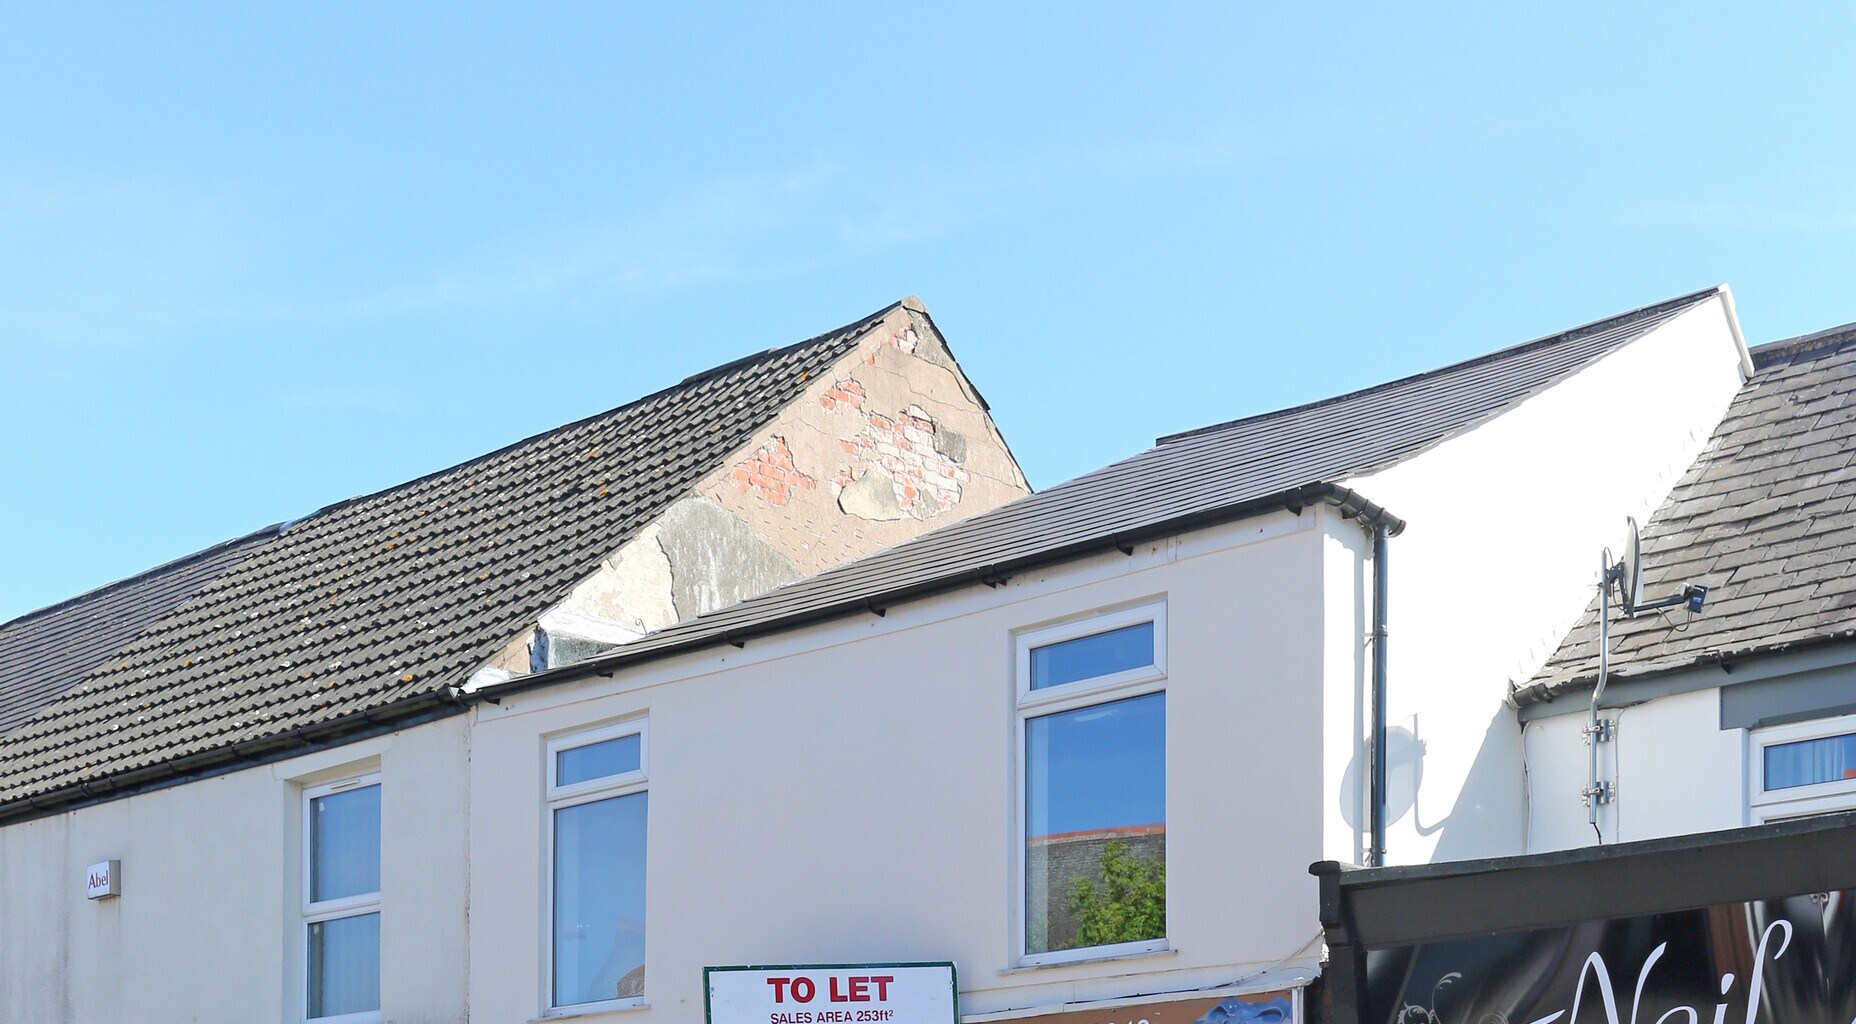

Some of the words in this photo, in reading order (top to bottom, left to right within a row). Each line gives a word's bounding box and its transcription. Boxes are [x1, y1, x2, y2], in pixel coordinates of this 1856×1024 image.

[88, 869, 109, 890] Abel
[767, 976, 816, 1004] TO
[829, 975, 894, 1003] LET
[770, 1012, 812, 1024] SALES
[816, 1010, 853, 1024] AREA
